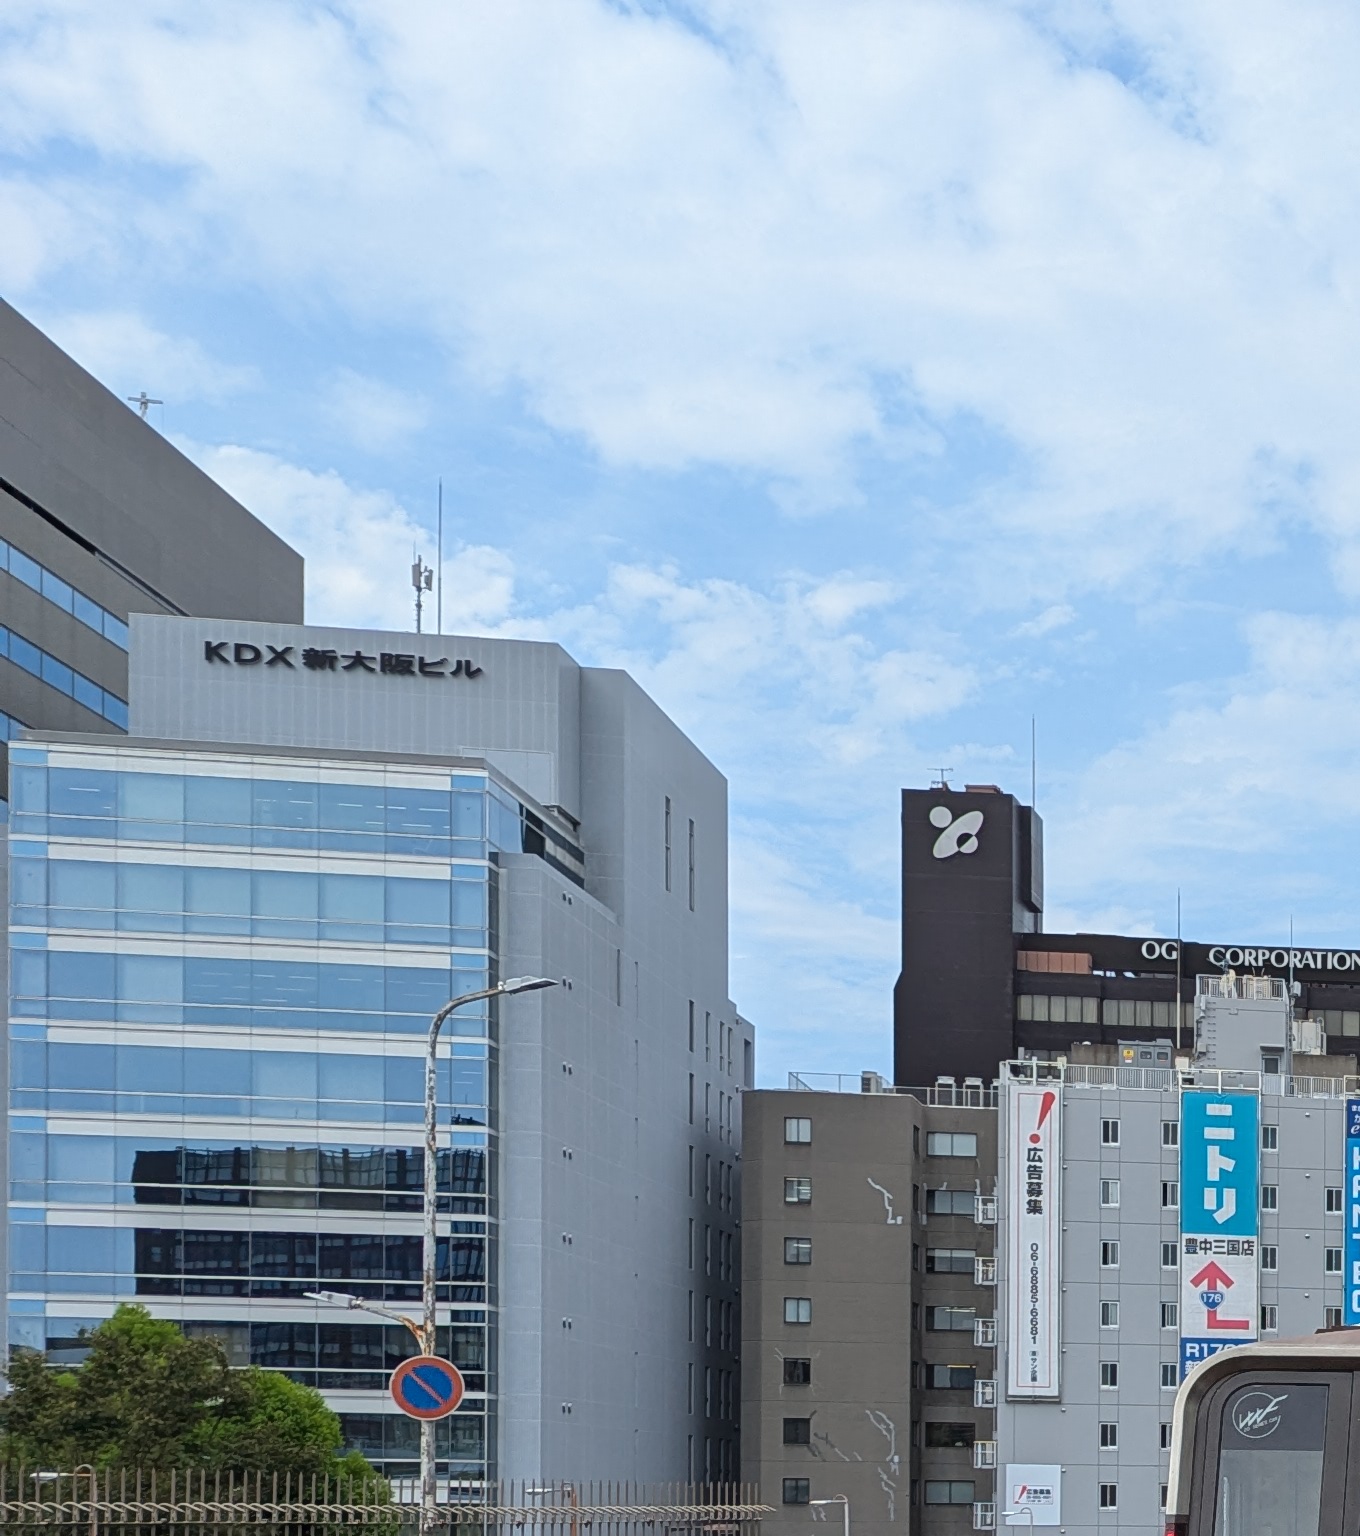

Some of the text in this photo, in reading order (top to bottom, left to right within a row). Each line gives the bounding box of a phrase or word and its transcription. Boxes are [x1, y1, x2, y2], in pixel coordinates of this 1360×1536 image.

[204, 640, 484, 679] KDX新大阪ビル
[1141, 940, 1178, 961] OG
[1026, 1147, 1043, 1215] 広告募集
[1203, 1103, 1236, 1225] ニトリ
[1184, 1237, 1255, 1257] 豊中三国店
[1030, 1242, 1039, 1345] 06-6885-6681
[1202, 1293, 1222, 1303] 176
